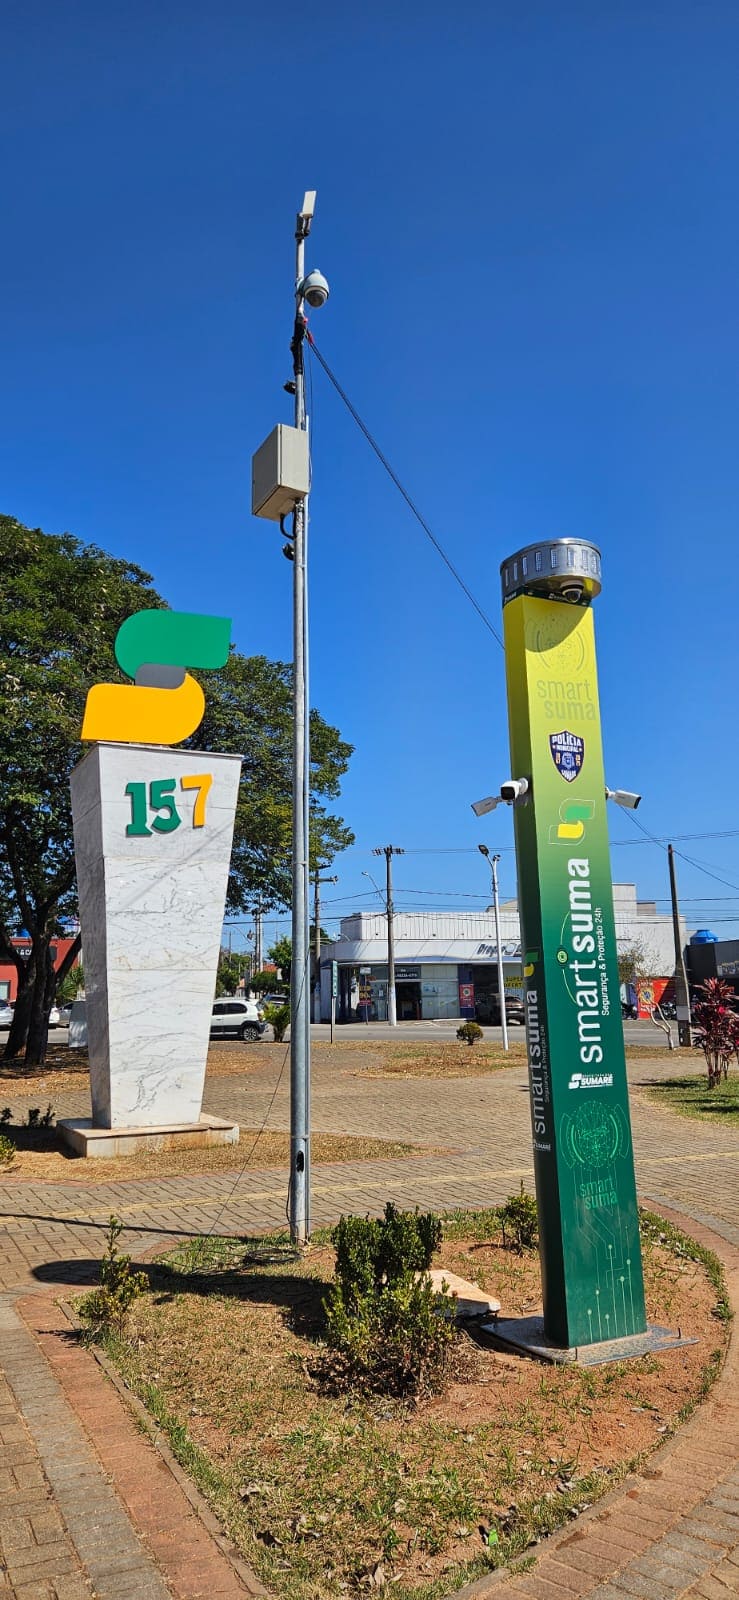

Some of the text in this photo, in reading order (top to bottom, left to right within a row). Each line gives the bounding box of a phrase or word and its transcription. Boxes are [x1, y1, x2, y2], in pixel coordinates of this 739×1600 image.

[537, 679, 590, 701] smart
[544, 701, 596, 721] suma
[125, 773, 213, 838] 157
[567, 858, 595, 953] suma
[594, 907, 610, 1016] Segurança & Proteção 24h
[569, 959, 603, 1064] smart
[526, 990, 546, 1135] smart suma
[579, 1176, 614, 1196] smart
[585, 1191, 618, 1210] suma
